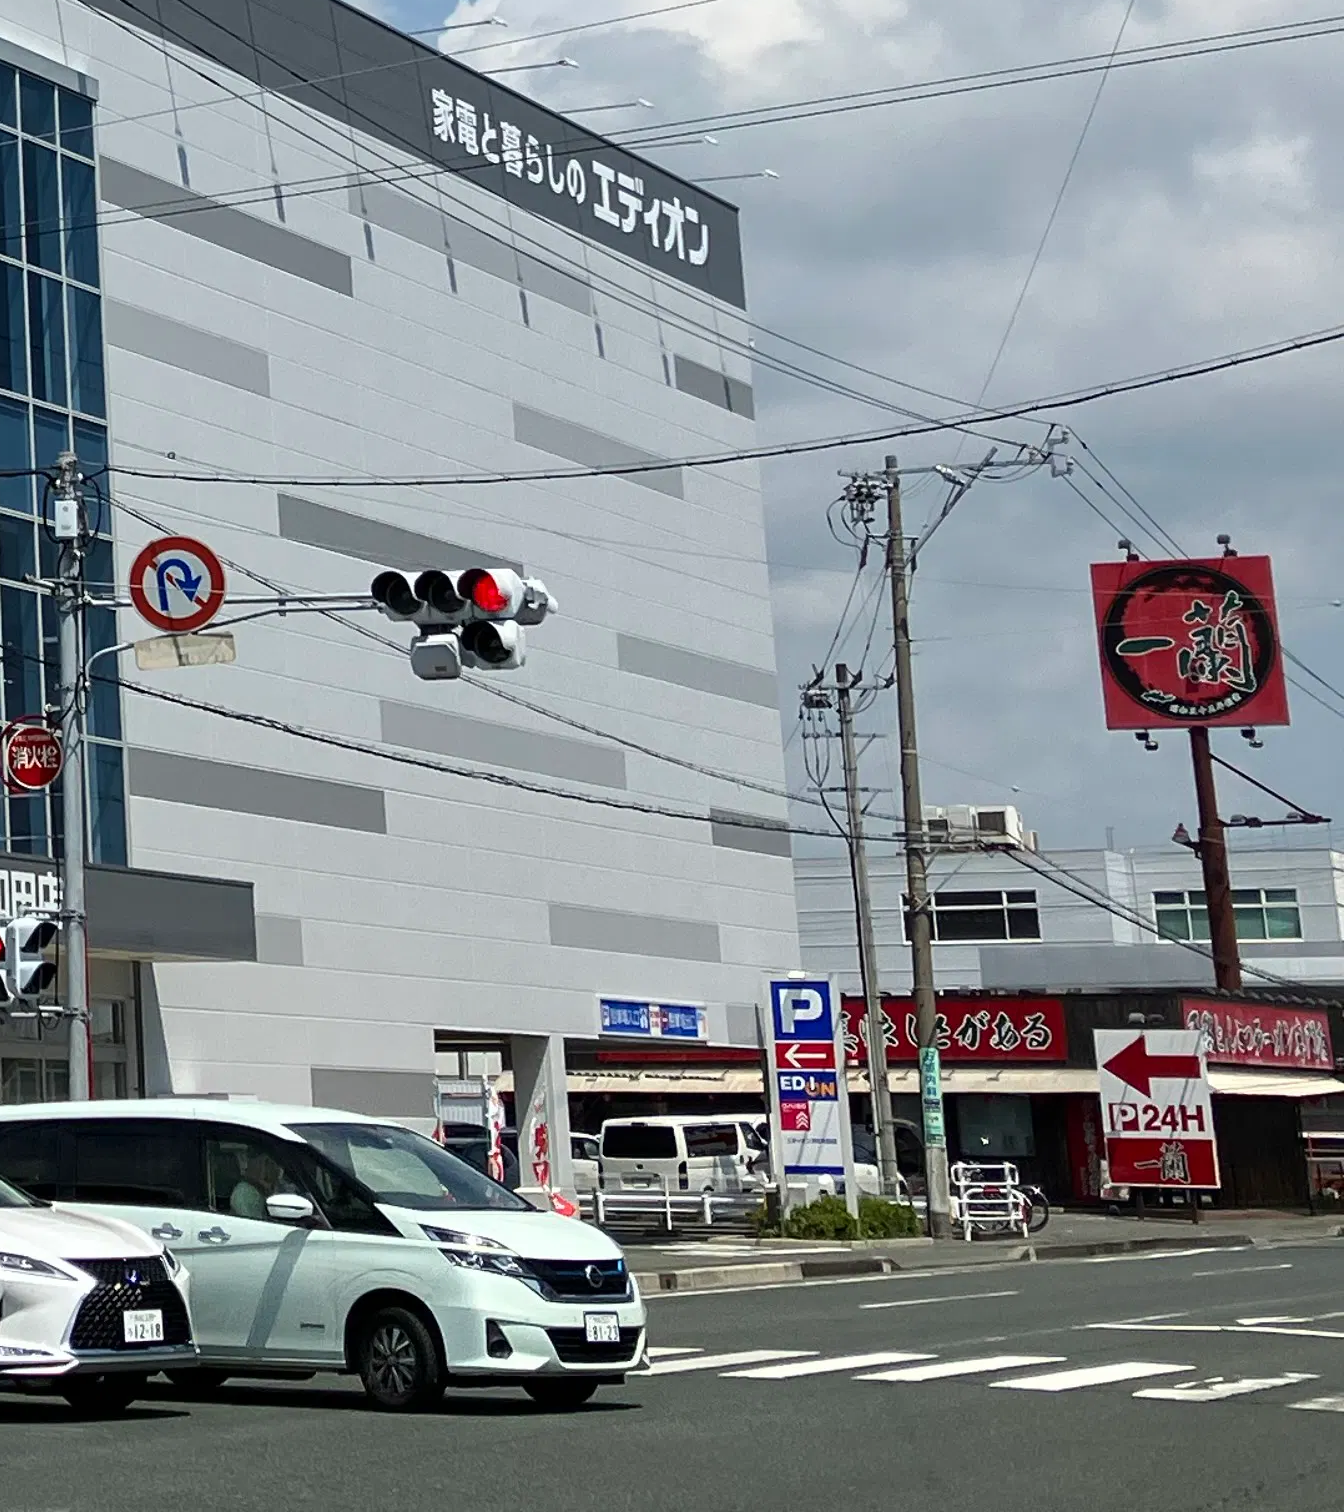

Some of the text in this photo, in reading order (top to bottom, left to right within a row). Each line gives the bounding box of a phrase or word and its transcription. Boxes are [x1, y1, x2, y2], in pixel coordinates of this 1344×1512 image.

[1115, 589, 1258, 693] 一蘭
[11, 744, 58, 769] 消火栓
[779, 988, 824, 1034] P
[779, 1075, 836, 1099] EDION
[1142, 1104, 1205, 1132] 24H
[1133, 1140, 1191, 1185] 一蘭
